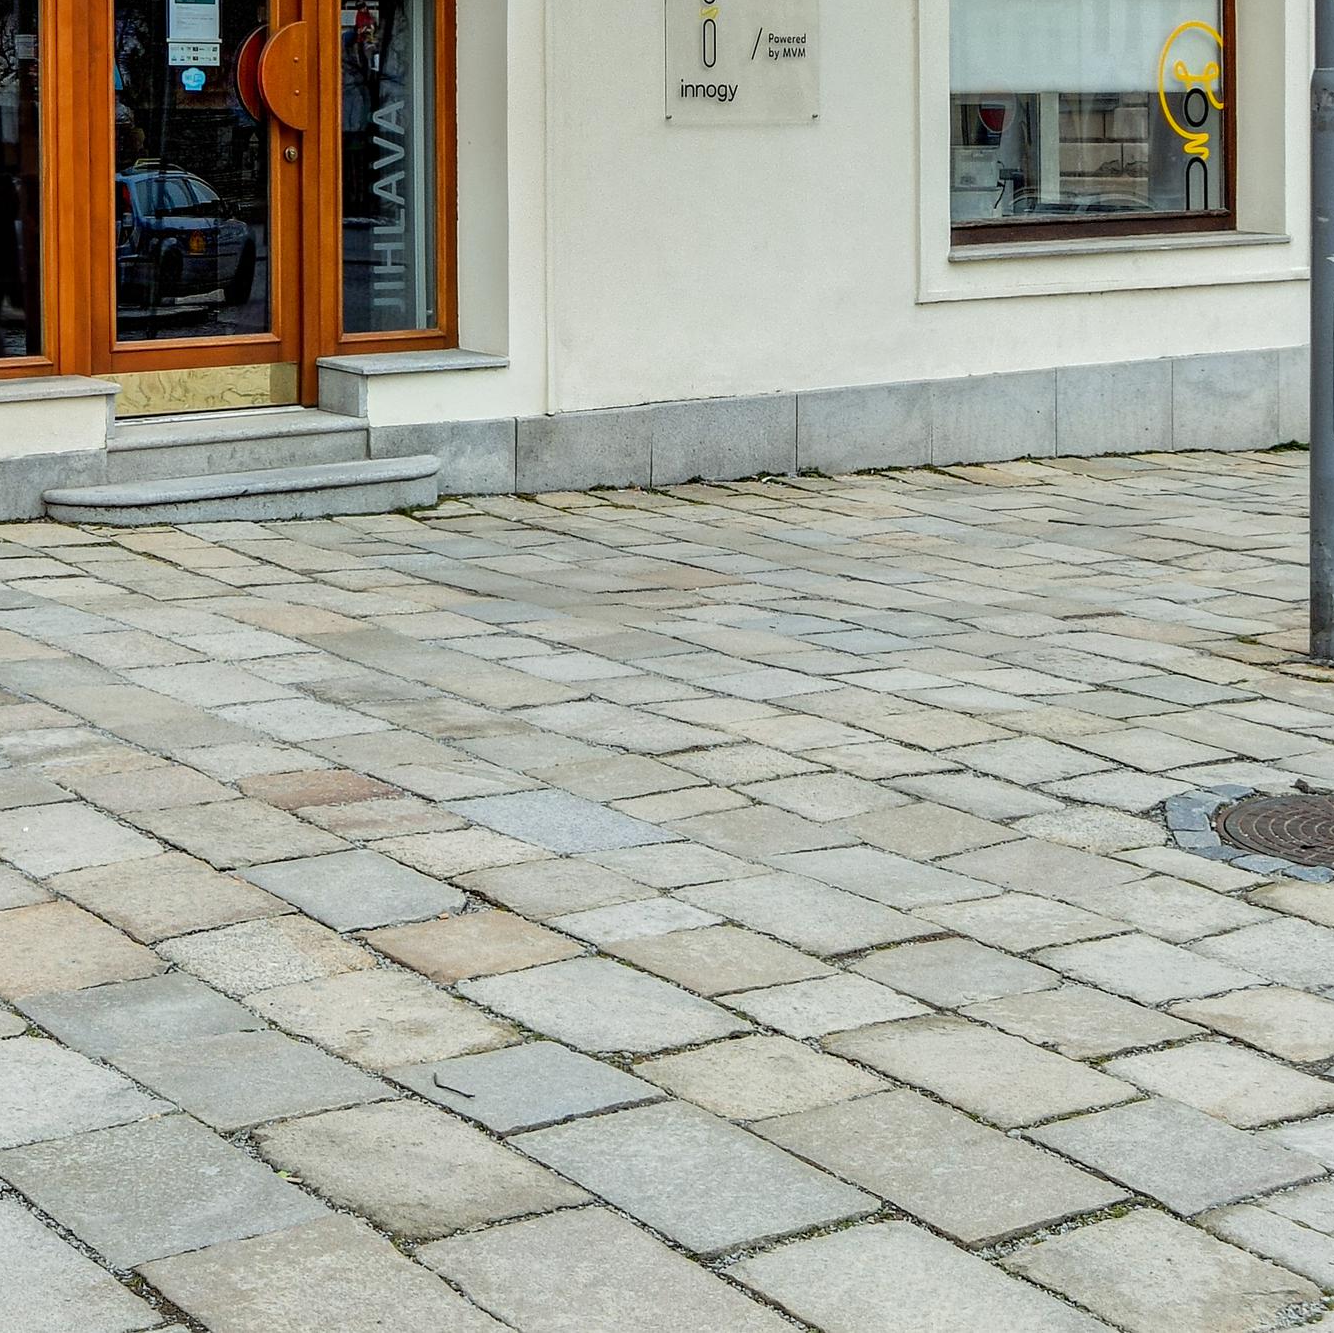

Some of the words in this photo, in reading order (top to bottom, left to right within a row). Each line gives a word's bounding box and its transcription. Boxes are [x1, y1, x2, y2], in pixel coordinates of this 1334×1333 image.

[768, 33, 807, 44] Powered
[768, 47, 780, 61] by
[782, 48, 806, 58] MVM
[680, 78, 739, 102] innogy
[373, 100, 405, 313] JIHLAVA
